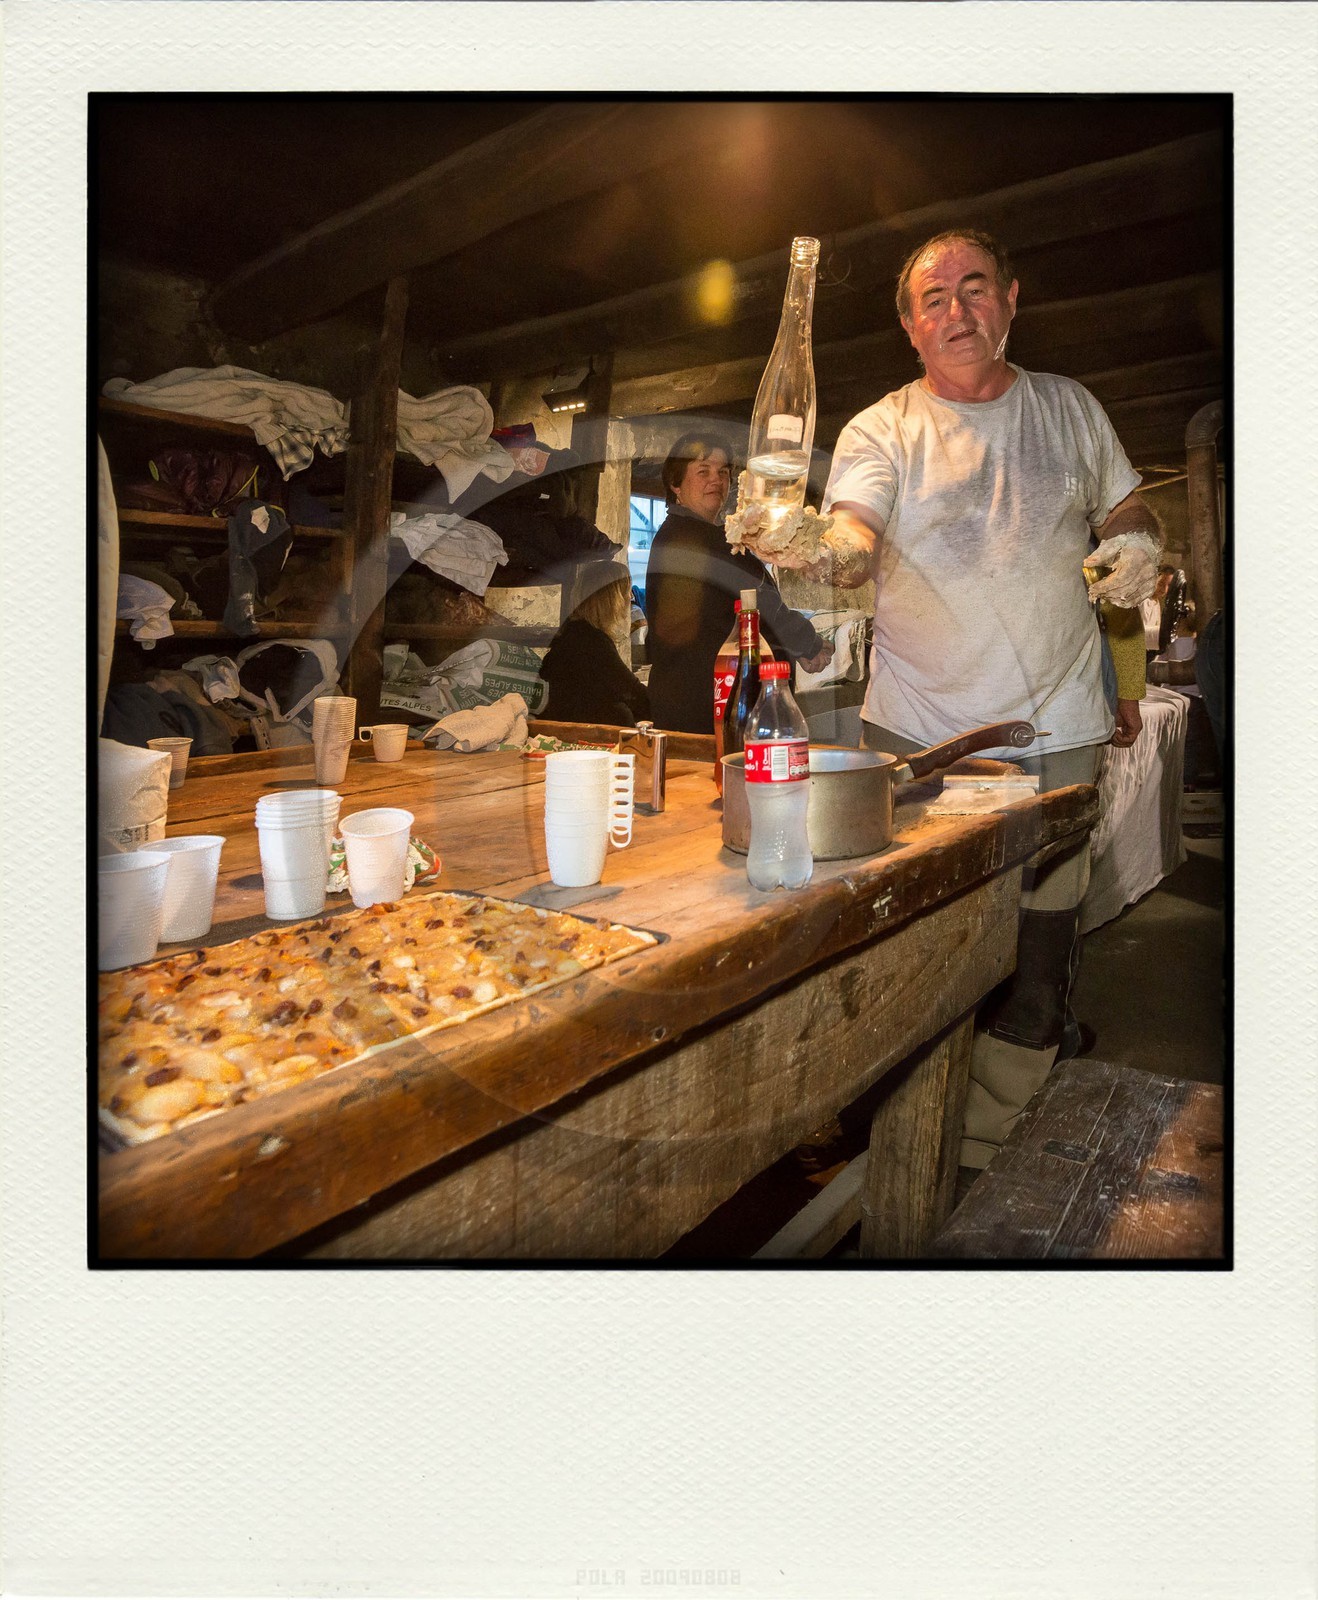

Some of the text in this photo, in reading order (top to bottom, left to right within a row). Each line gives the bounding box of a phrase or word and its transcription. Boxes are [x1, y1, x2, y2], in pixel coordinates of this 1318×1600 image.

[484, 677, 542, 697] HAUTES ALPES
[401, 700, 432, 713] ALPES
